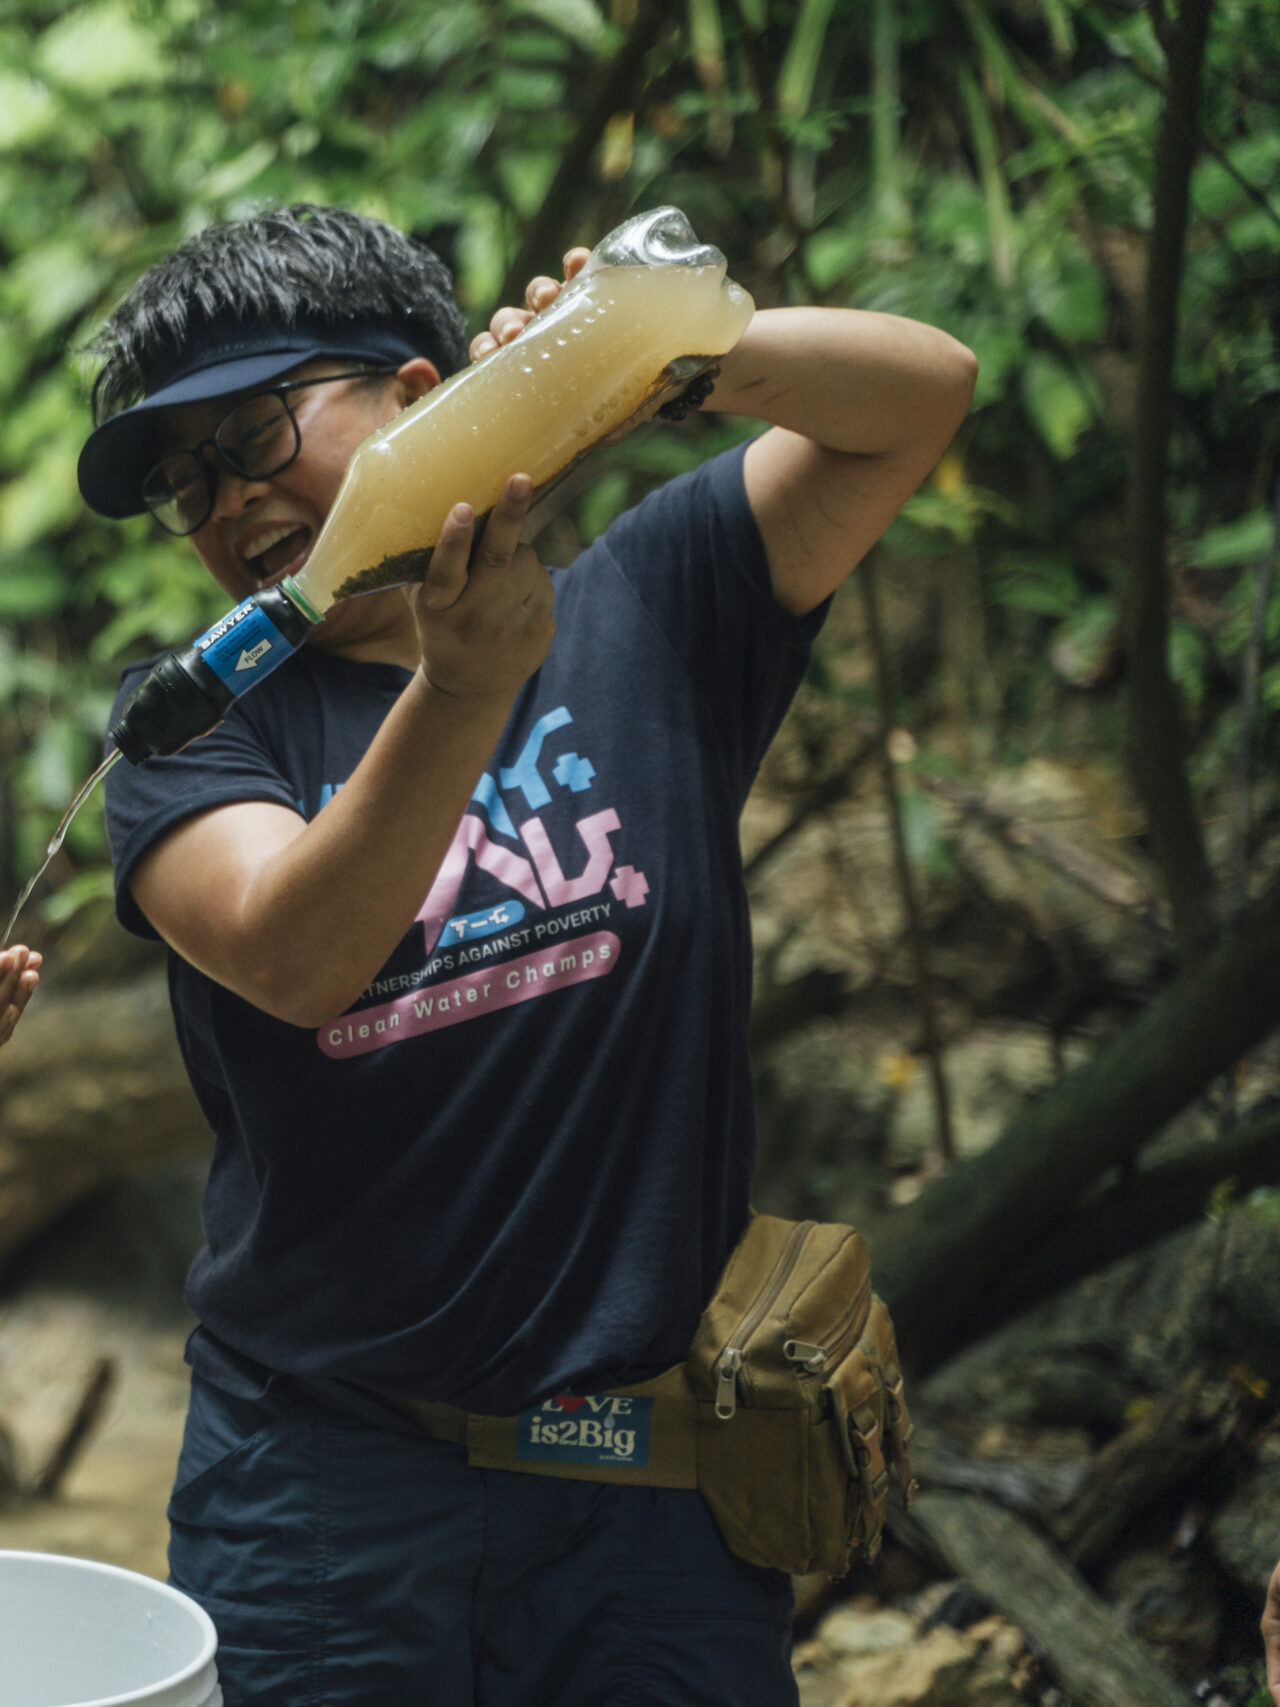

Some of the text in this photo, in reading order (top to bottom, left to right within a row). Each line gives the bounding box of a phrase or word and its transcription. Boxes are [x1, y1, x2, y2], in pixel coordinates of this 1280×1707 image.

[199, 603, 254, 650] SAWYER
[244, 645, 264, 664] FLOW
[360, 955, 455, 999] TNERSHIPS
[458, 929, 531, 966] AGAINST
[536, 903, 611, 940] POVERTY
[329, 944, 611, 1046] Clean Water Champs
